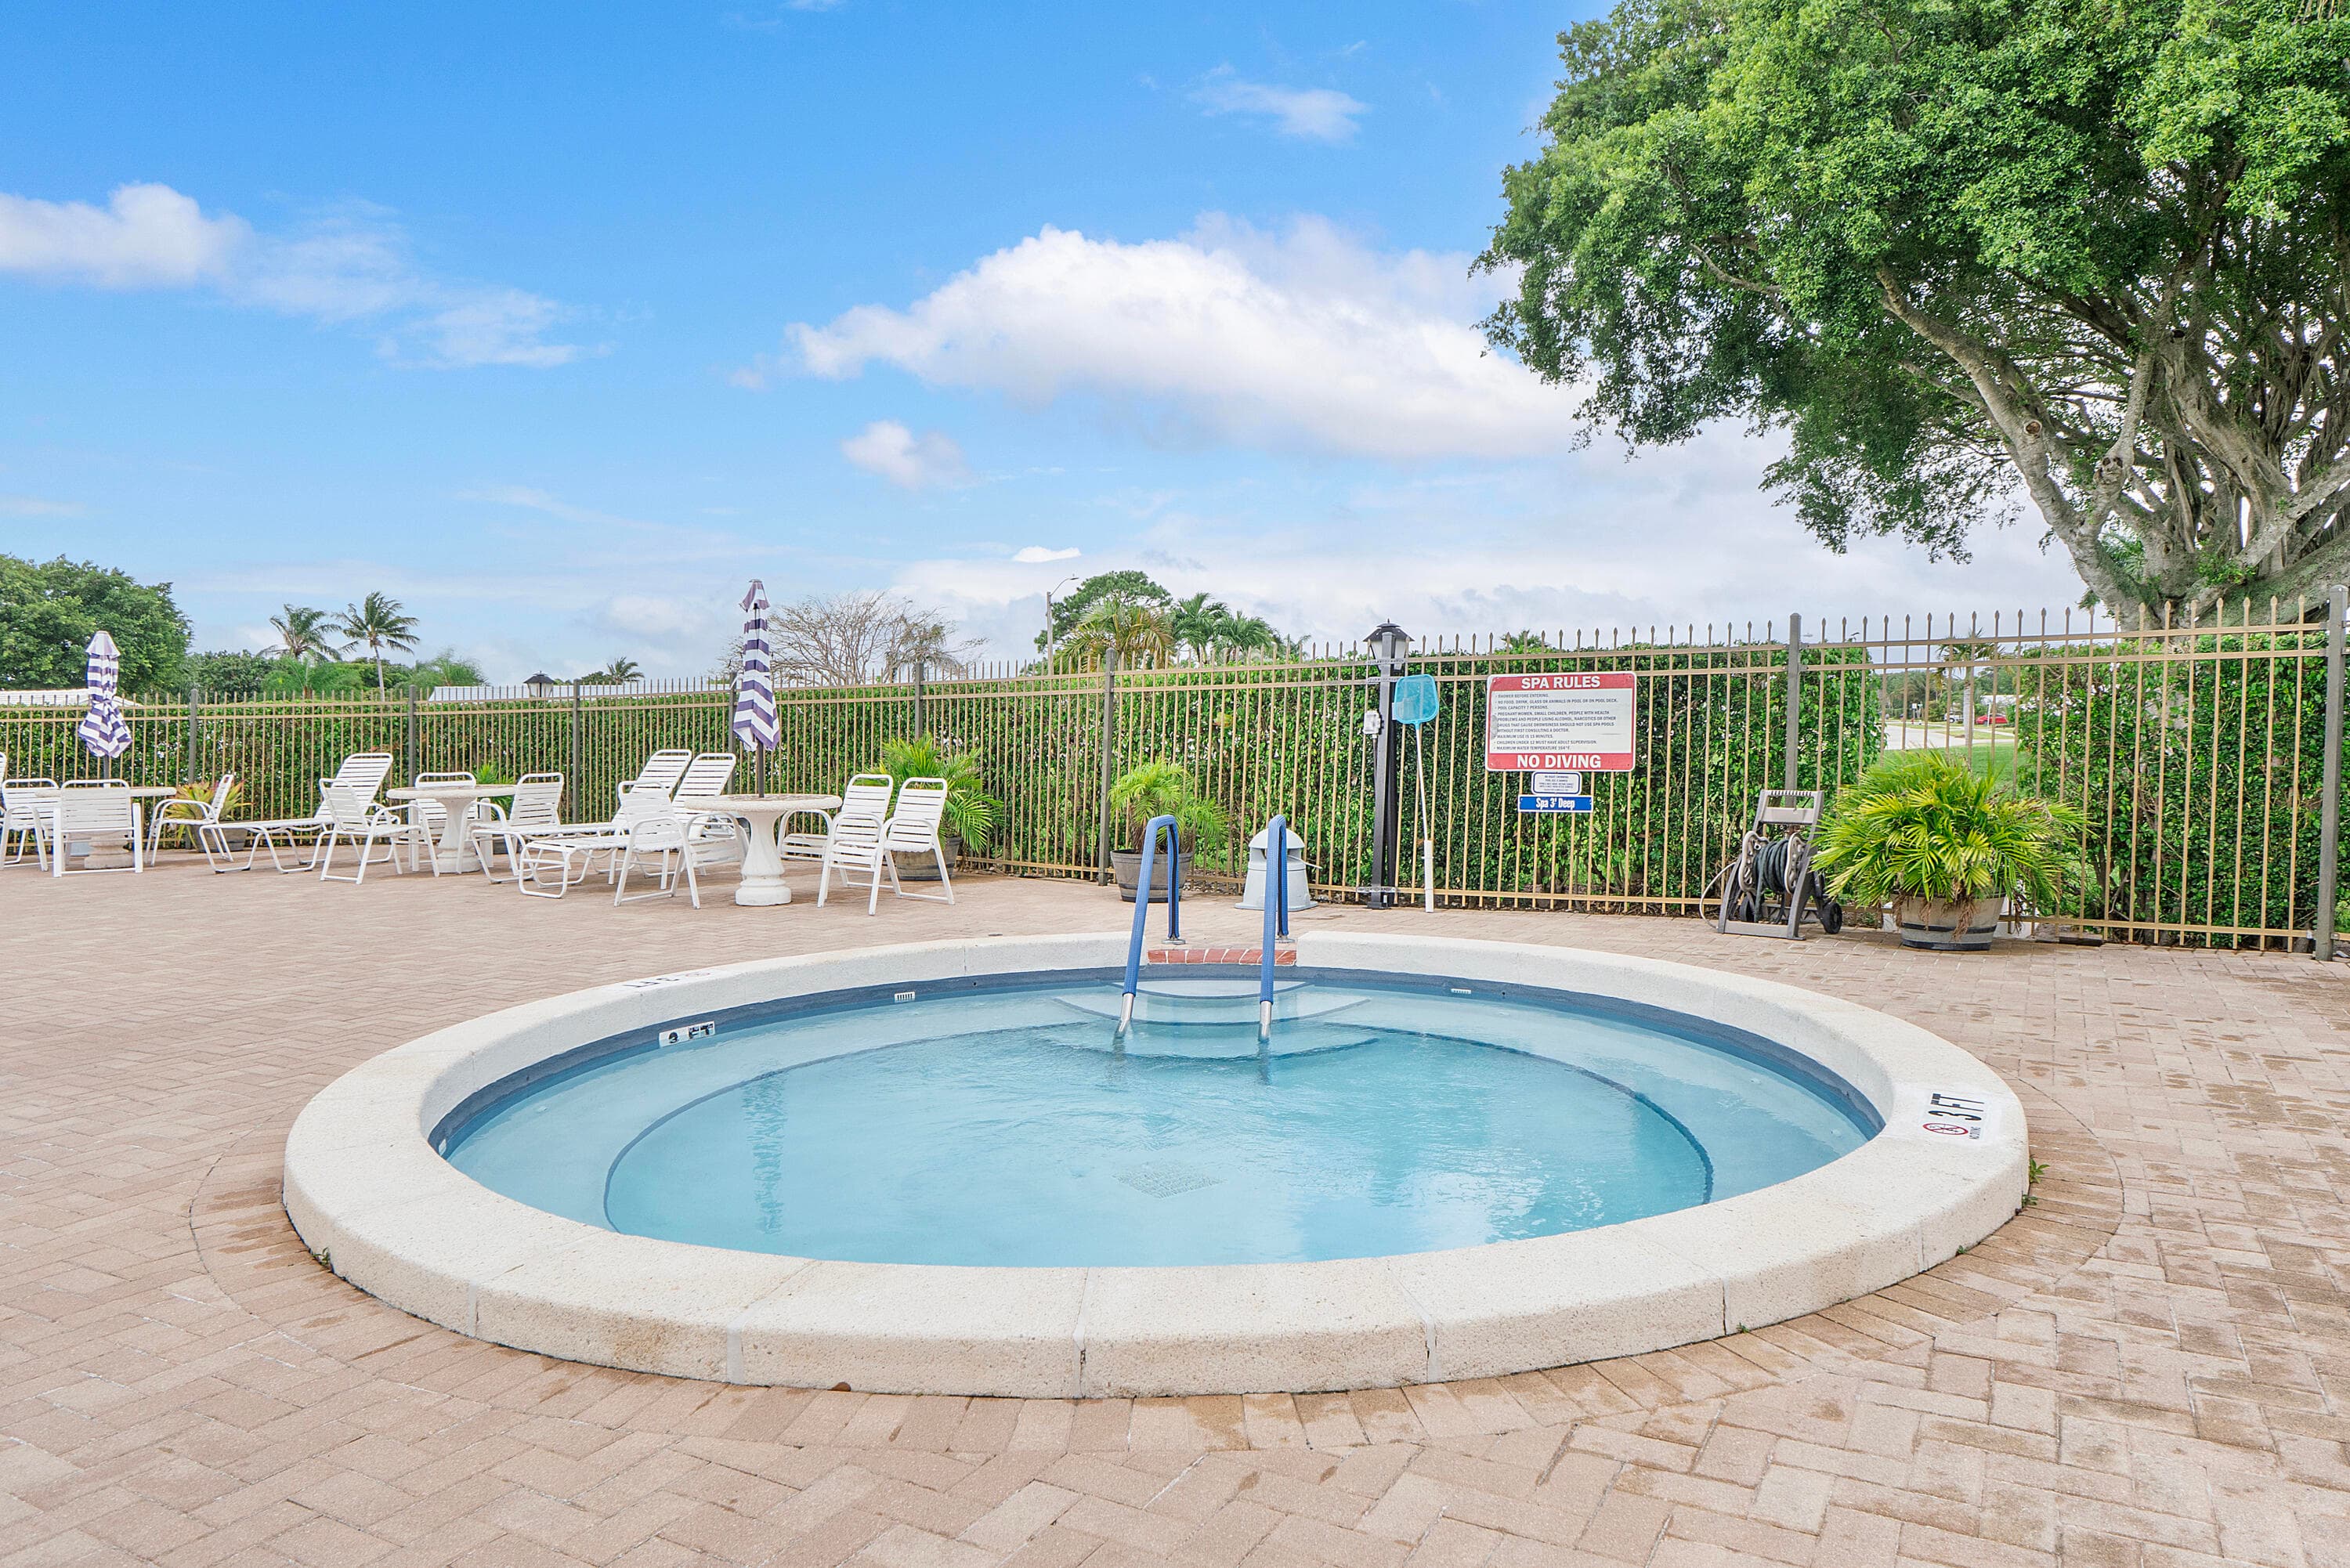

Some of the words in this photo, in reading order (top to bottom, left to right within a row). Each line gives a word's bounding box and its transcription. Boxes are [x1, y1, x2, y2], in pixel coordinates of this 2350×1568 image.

[1521, 677, 1549, 688] SPA
[1553, 676, 1600, 688] RULES
[1517, 756, 1540, 768] NO
[1545, 755, 1602, 768] DIVING
[1535, 797, 1548, 810] Spa
[1549, 797, 1557, 807] 3'
[1558, 798, 1575, 810] Deep
[1930, 1093, 1985, 1112] FT
[1928, 1110, 1982, 1121] 3
